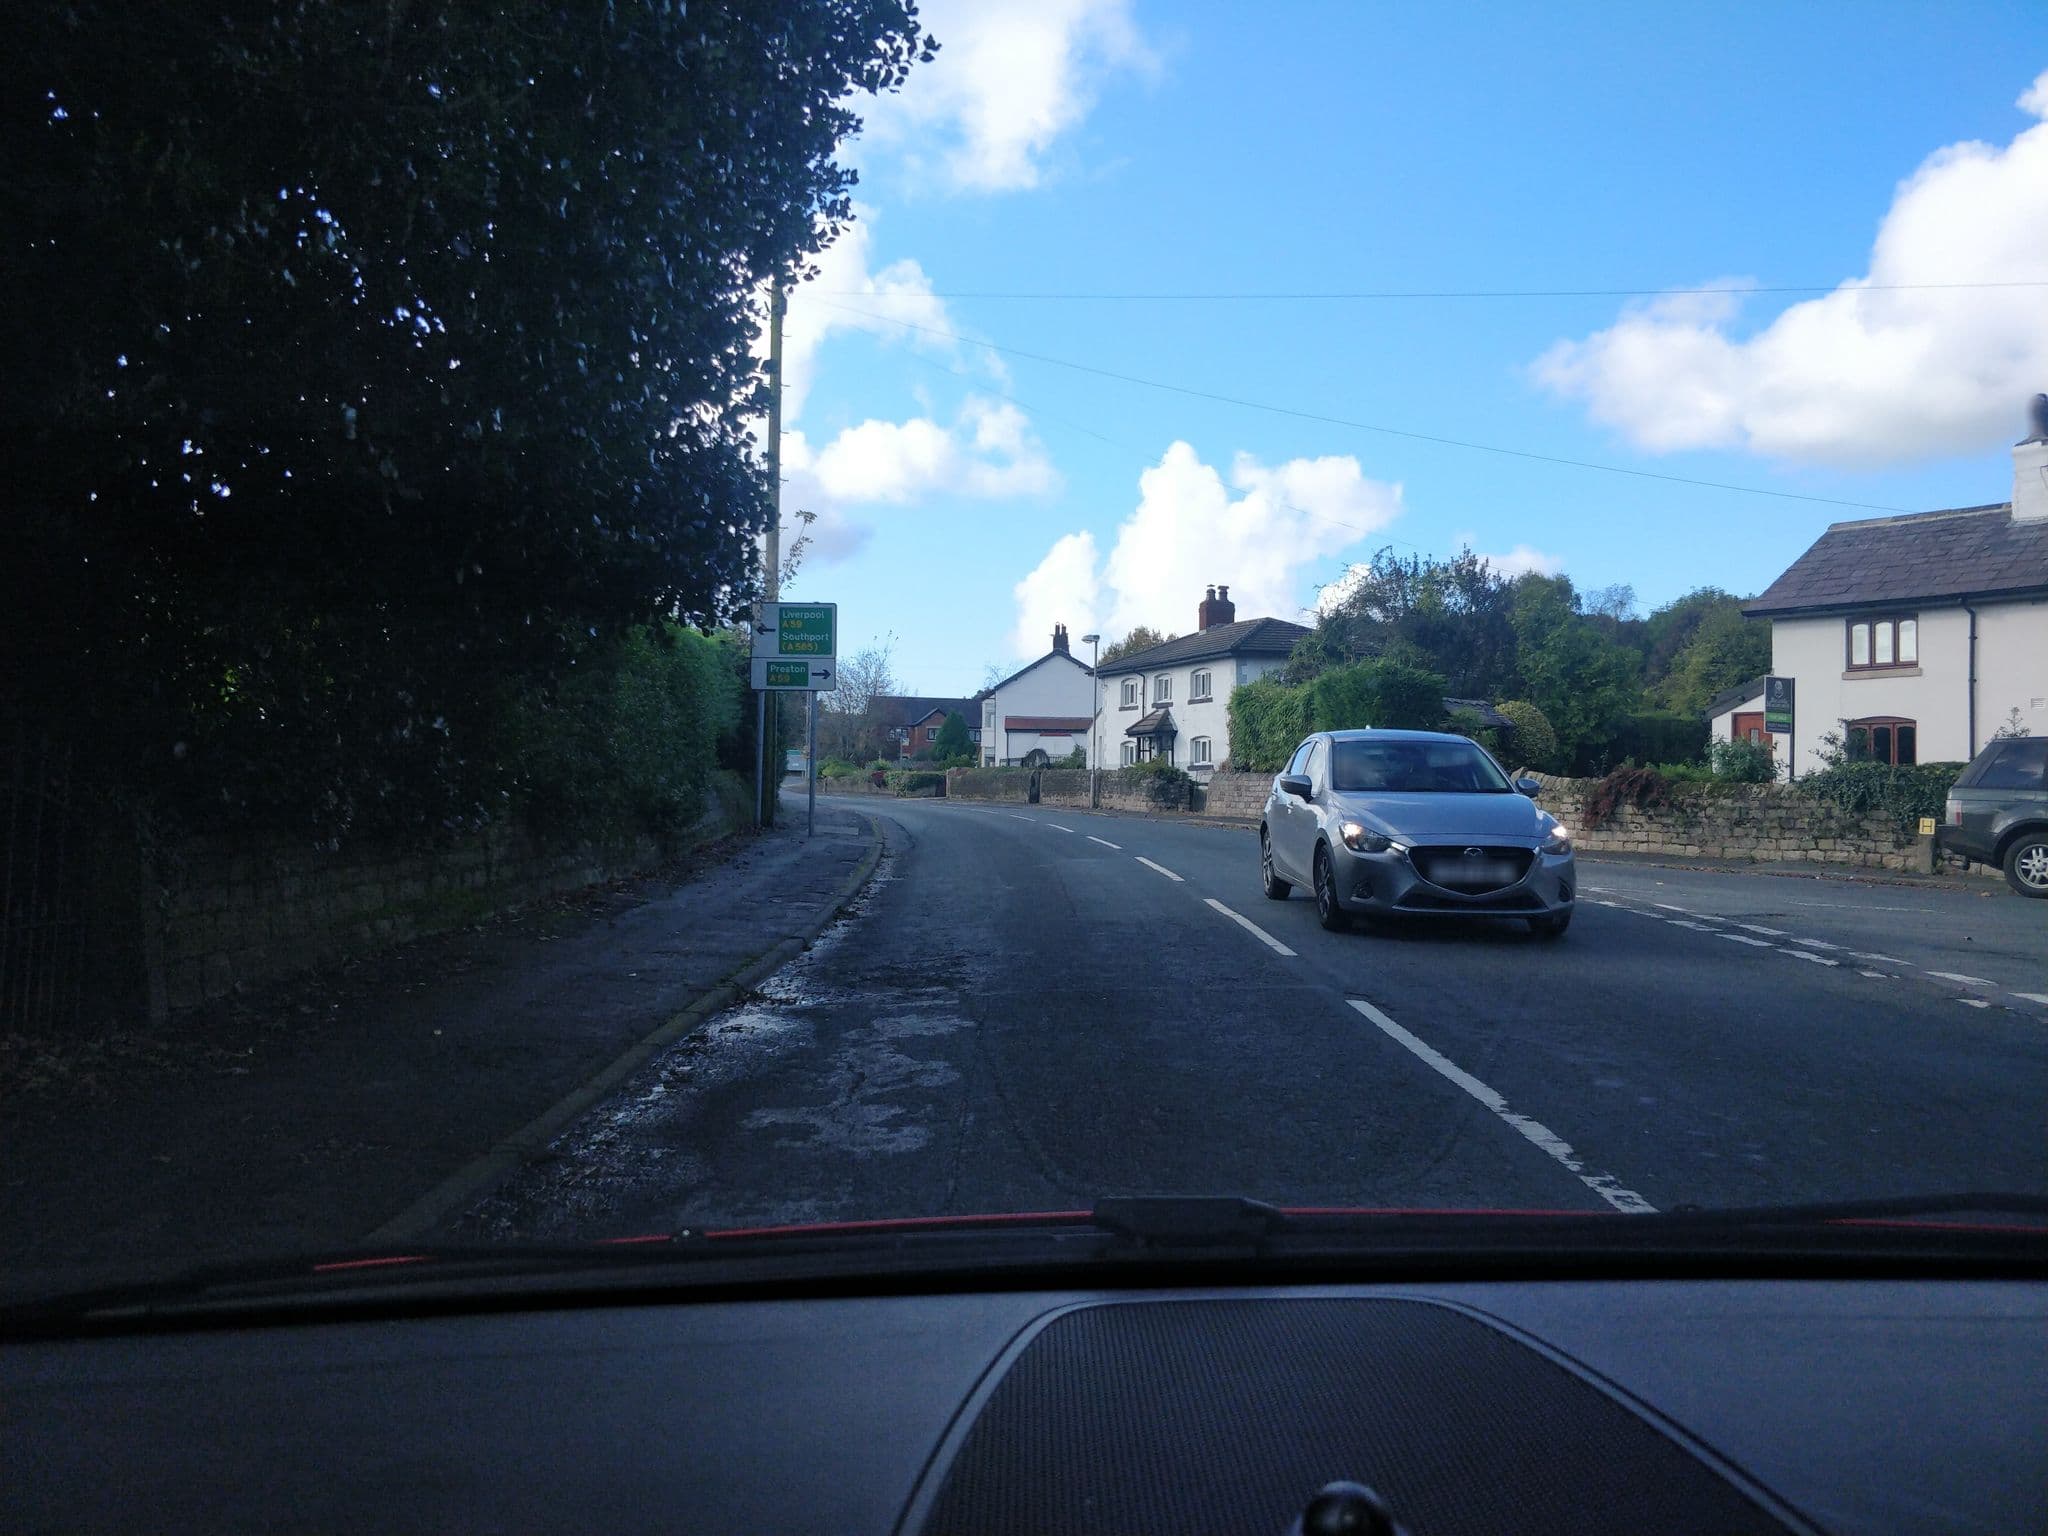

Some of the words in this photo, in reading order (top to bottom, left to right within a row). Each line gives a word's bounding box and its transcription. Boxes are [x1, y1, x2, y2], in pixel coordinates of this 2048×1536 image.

[782, 610, 824, 619] Liverpool
[782, 632, 829, 642] Southport
[770, 664, 806, 673] Preston
[1921, 819, 1933, 833] H
